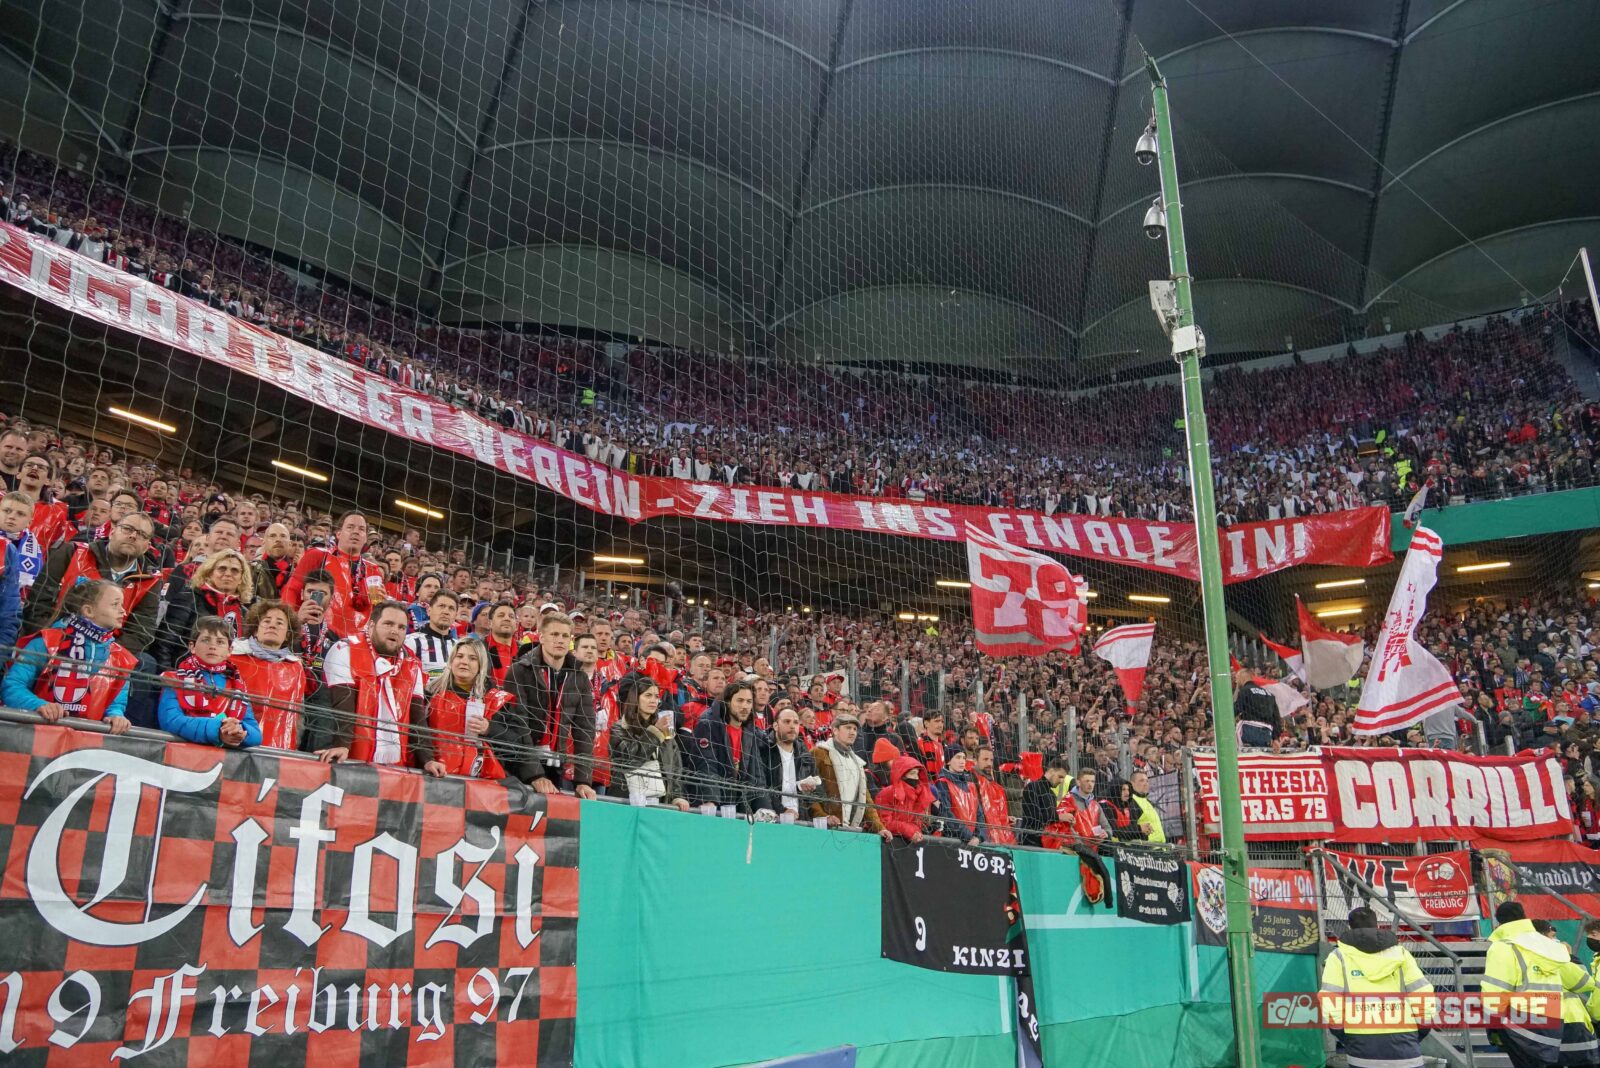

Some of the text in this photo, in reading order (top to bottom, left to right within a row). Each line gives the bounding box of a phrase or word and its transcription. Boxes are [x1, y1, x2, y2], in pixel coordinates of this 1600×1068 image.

[463, 410, 641, 519] VEREIN
[692, 484, 829, 525] ZIEH
[855, 500, 957, 538] INS
[988, 513, 1176, 568] FINALE
[63, 701, 88, 712] BURG
[1199, 770, 1326, 794] STHESIA
[1206, 797, 1327, 822] UTRAS 79
[24, 748, 544, 949] Tifosi
[1248, 871, 1291, 903] rtenau
[1425, 897, 1463, 909] FREIBURG
[1263, 914, 1291, 925] 25 Jahre
[1260, 926, 1276, 936] 1990
[1281, 928, 1298, 938] 2015
[110, 961, 447, 1062] Freiburg
[467, 966, 534, 1025] 97
